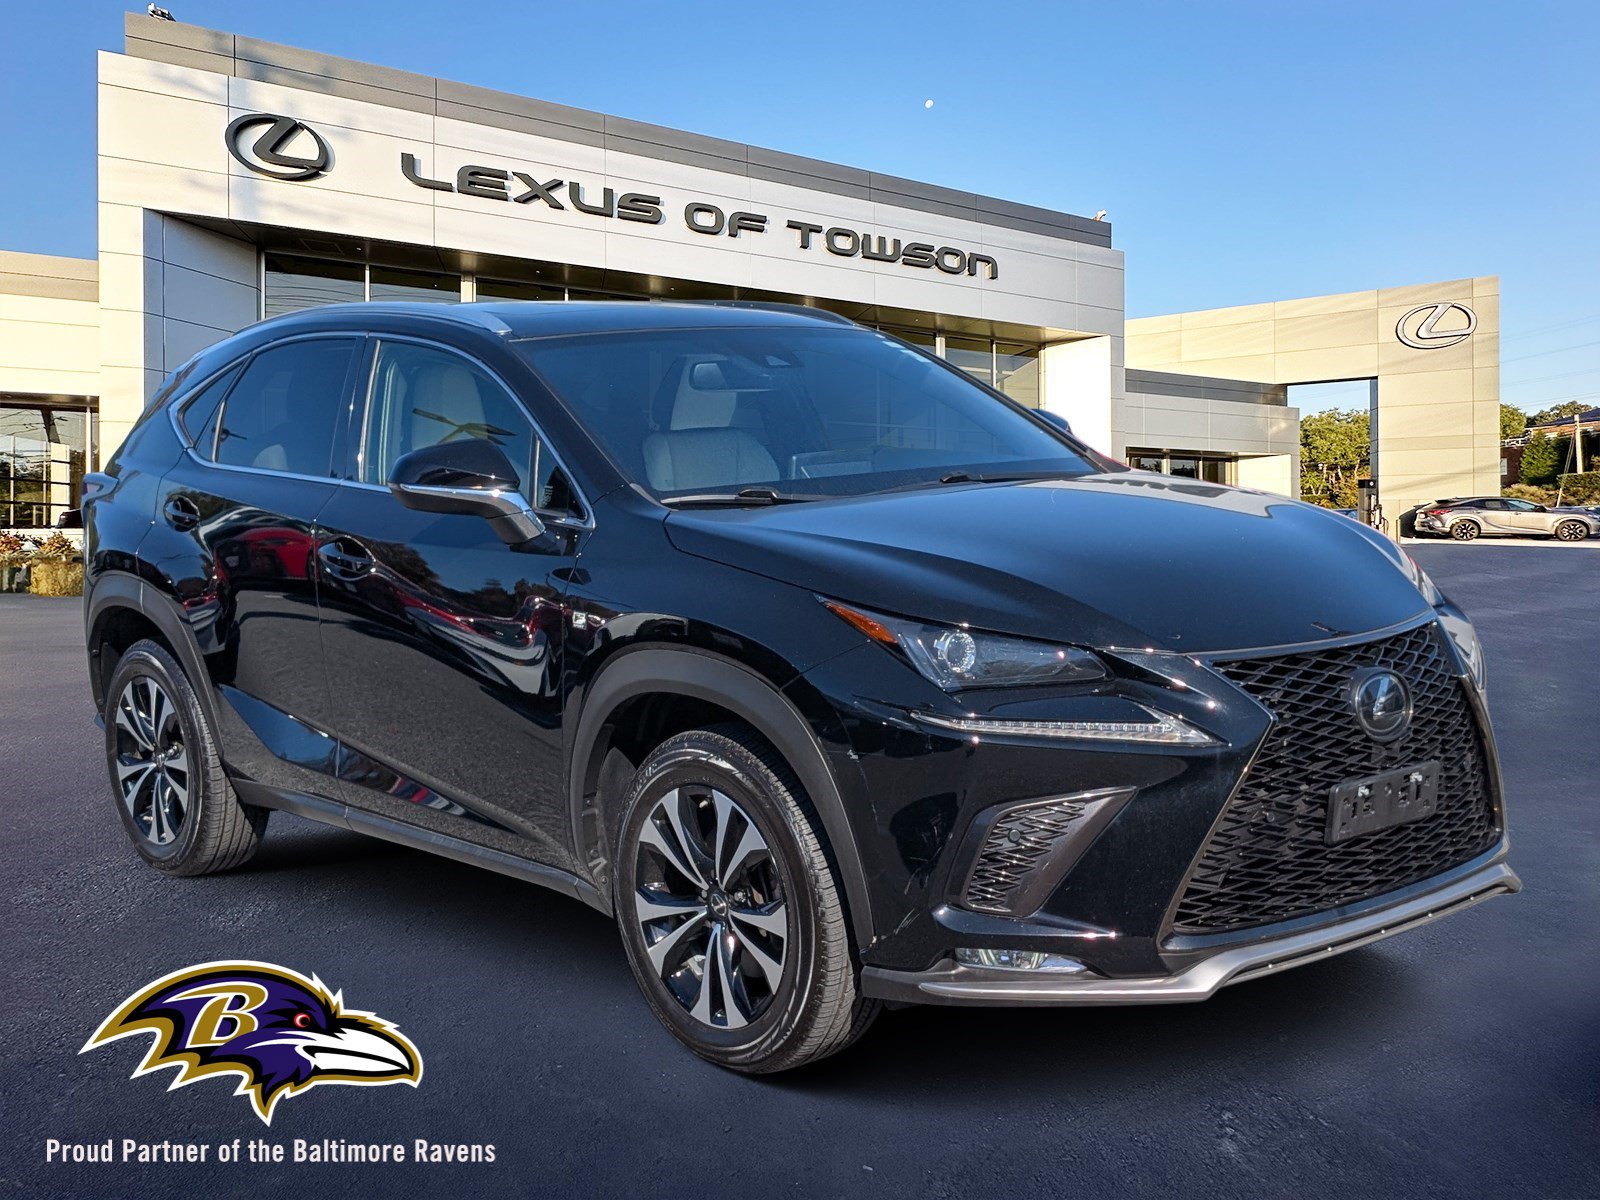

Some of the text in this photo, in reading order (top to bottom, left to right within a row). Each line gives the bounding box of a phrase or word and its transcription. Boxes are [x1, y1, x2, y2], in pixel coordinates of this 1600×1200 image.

[400, 152, 999, 280] LEXUS OF TOWSON
